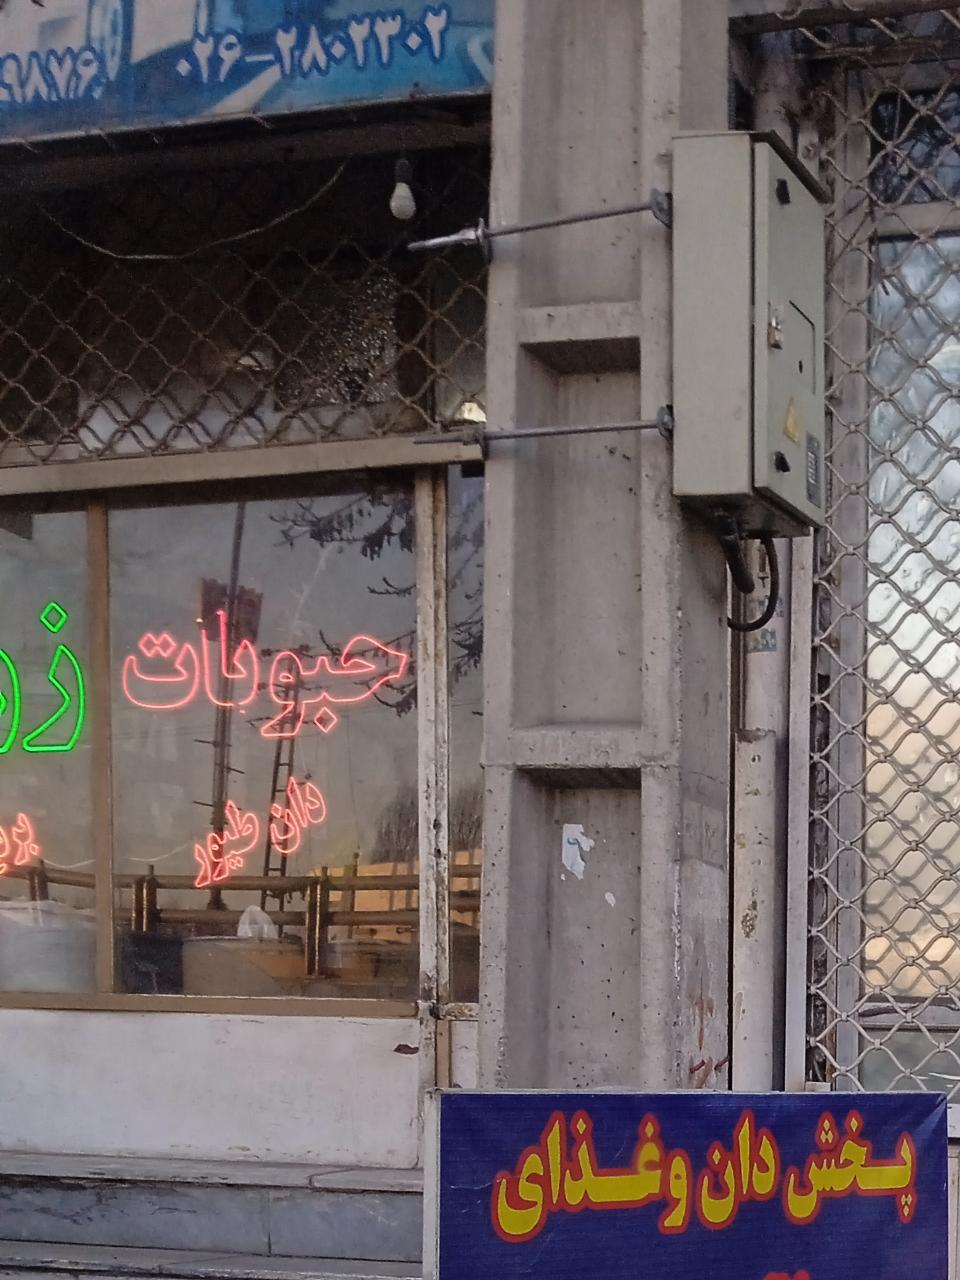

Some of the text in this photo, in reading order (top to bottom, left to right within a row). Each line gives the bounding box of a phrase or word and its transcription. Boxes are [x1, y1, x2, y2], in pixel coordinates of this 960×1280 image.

[194, 775, 327, 888] دان طیور
[699, 1114, 777, 1225] دان
[785, 1115, 915, 1219] پخش
